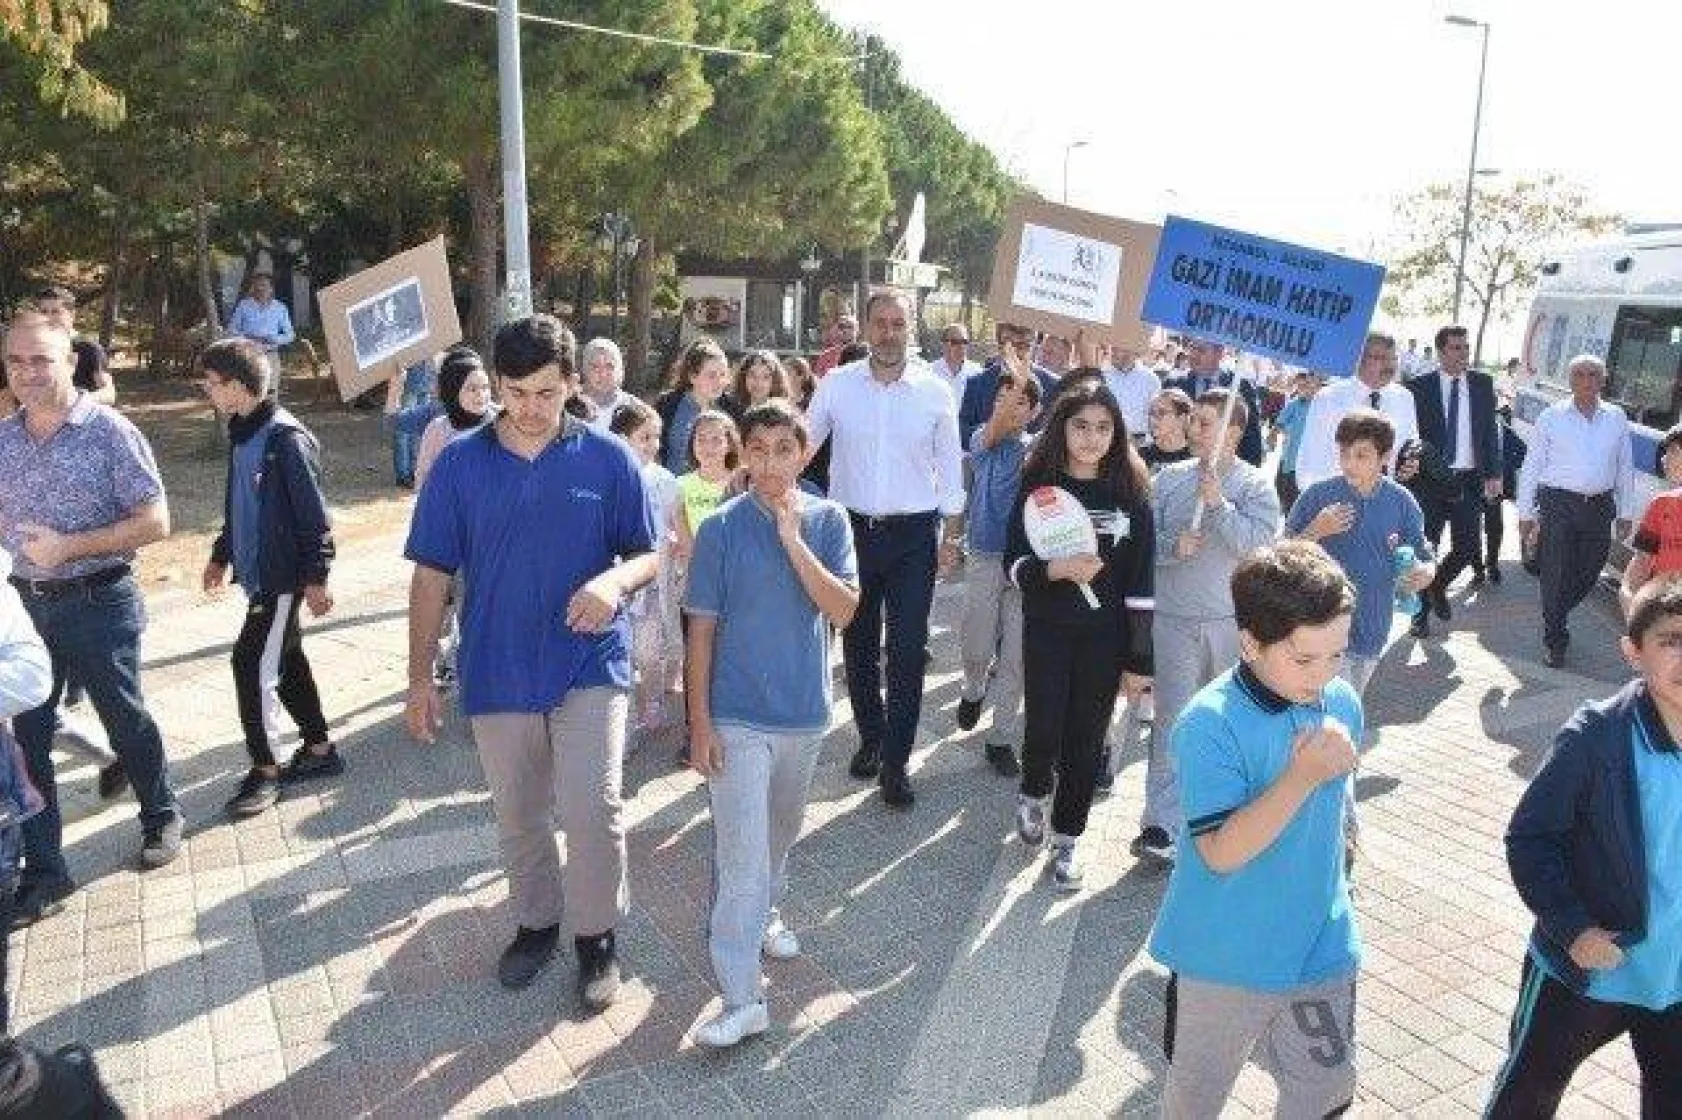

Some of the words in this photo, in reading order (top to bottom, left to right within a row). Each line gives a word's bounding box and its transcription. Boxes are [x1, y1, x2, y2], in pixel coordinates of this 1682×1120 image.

[1171, 254, 1222, 290] GAZİ
[1223, 259, 1283, 308] İMAM
[1284, 284, 1354, 323] HATİP
[1186, 300, 1316, 356] ORTAOKULU
[1290, 1001, 1346, 1067] 9
